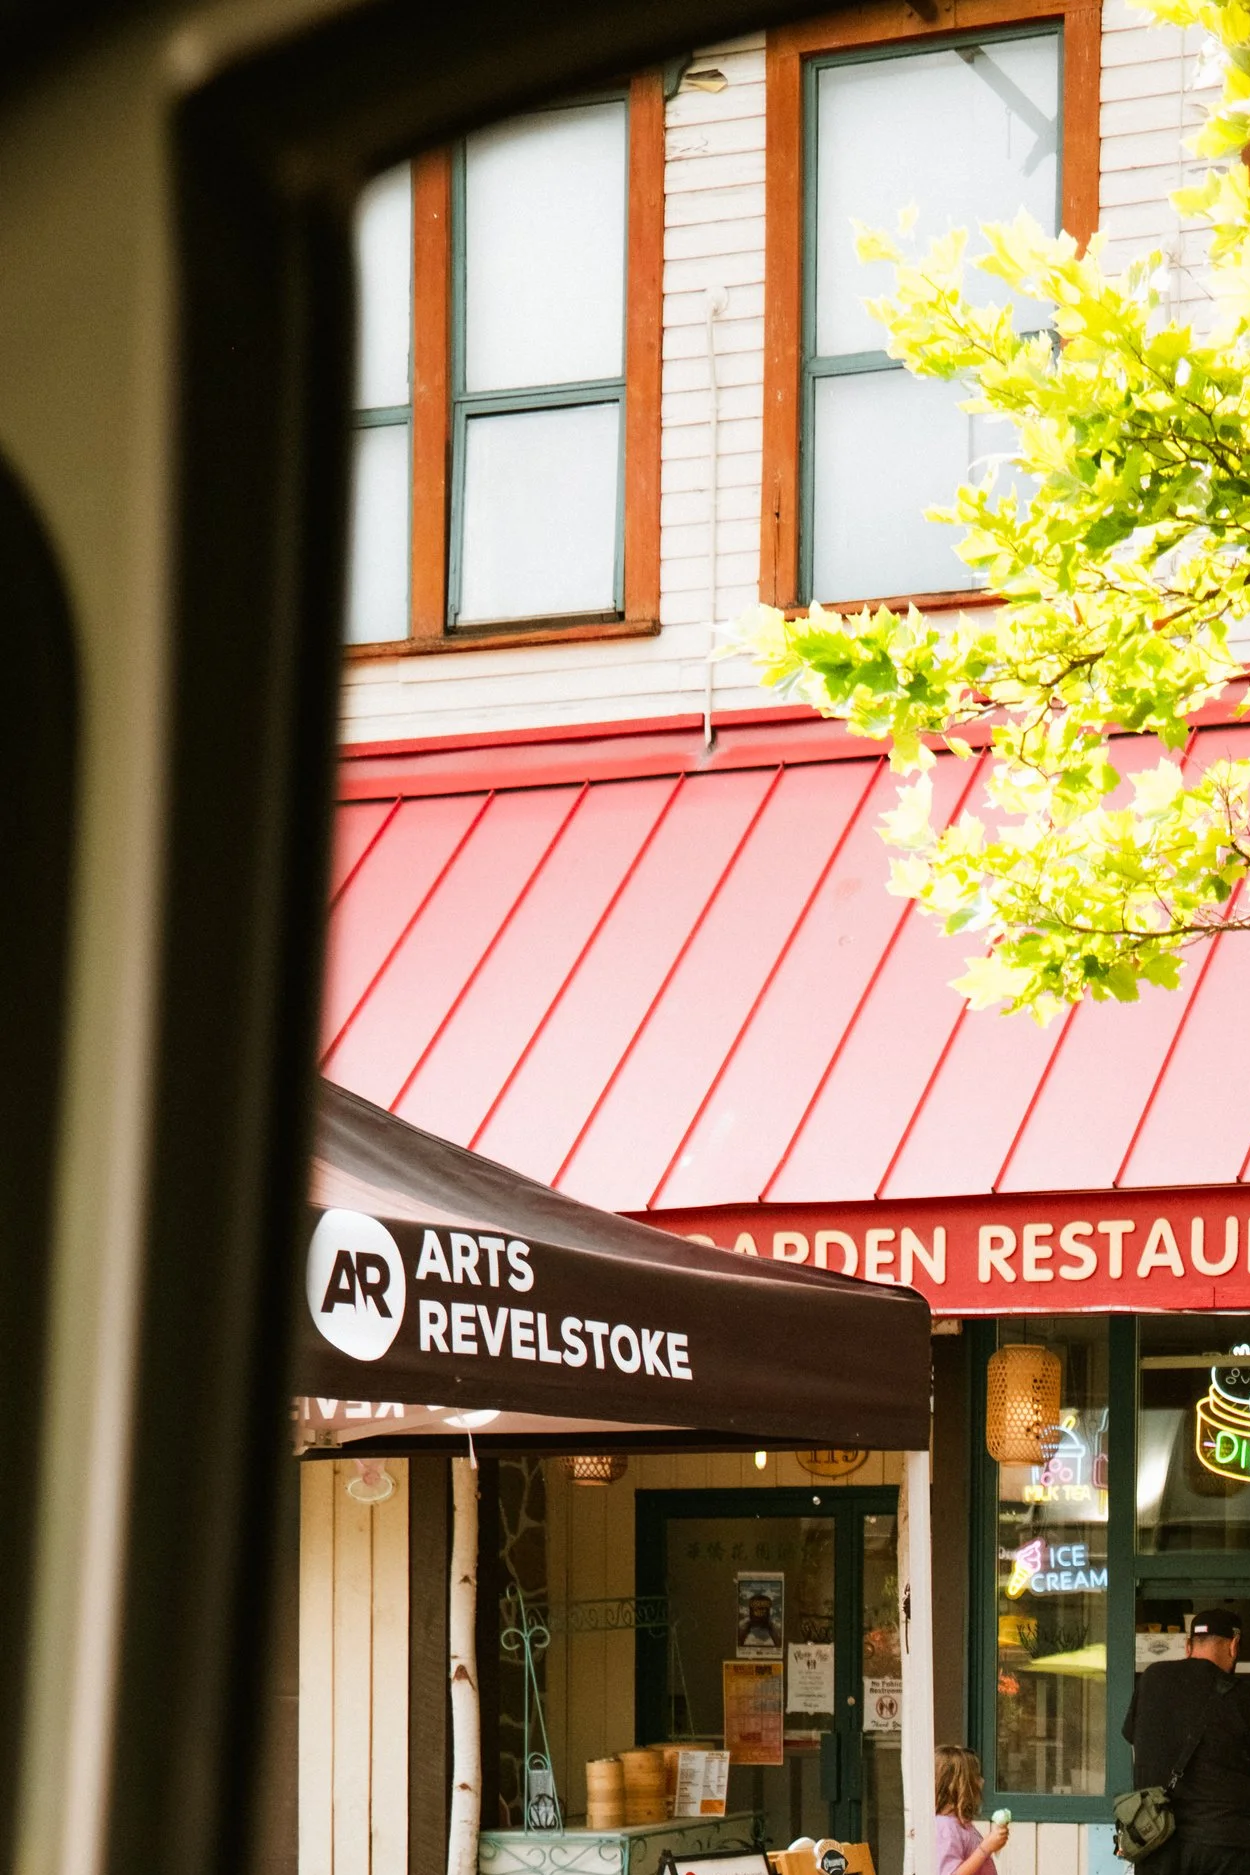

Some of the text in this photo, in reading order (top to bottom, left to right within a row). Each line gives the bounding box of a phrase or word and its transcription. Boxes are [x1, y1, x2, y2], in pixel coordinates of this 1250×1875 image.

[415, 1229, 535, 1293] ARTS
[686, 1226, 946, 1285] RDEN
[418, 1299, 693, 1381] REVELSTOKE
[1024, 1484, 1091, 1502] MILK TEA
[1050, 1544, 1085, 1568] ICE
[1031, 1568, 1108, 1593] CREAM
